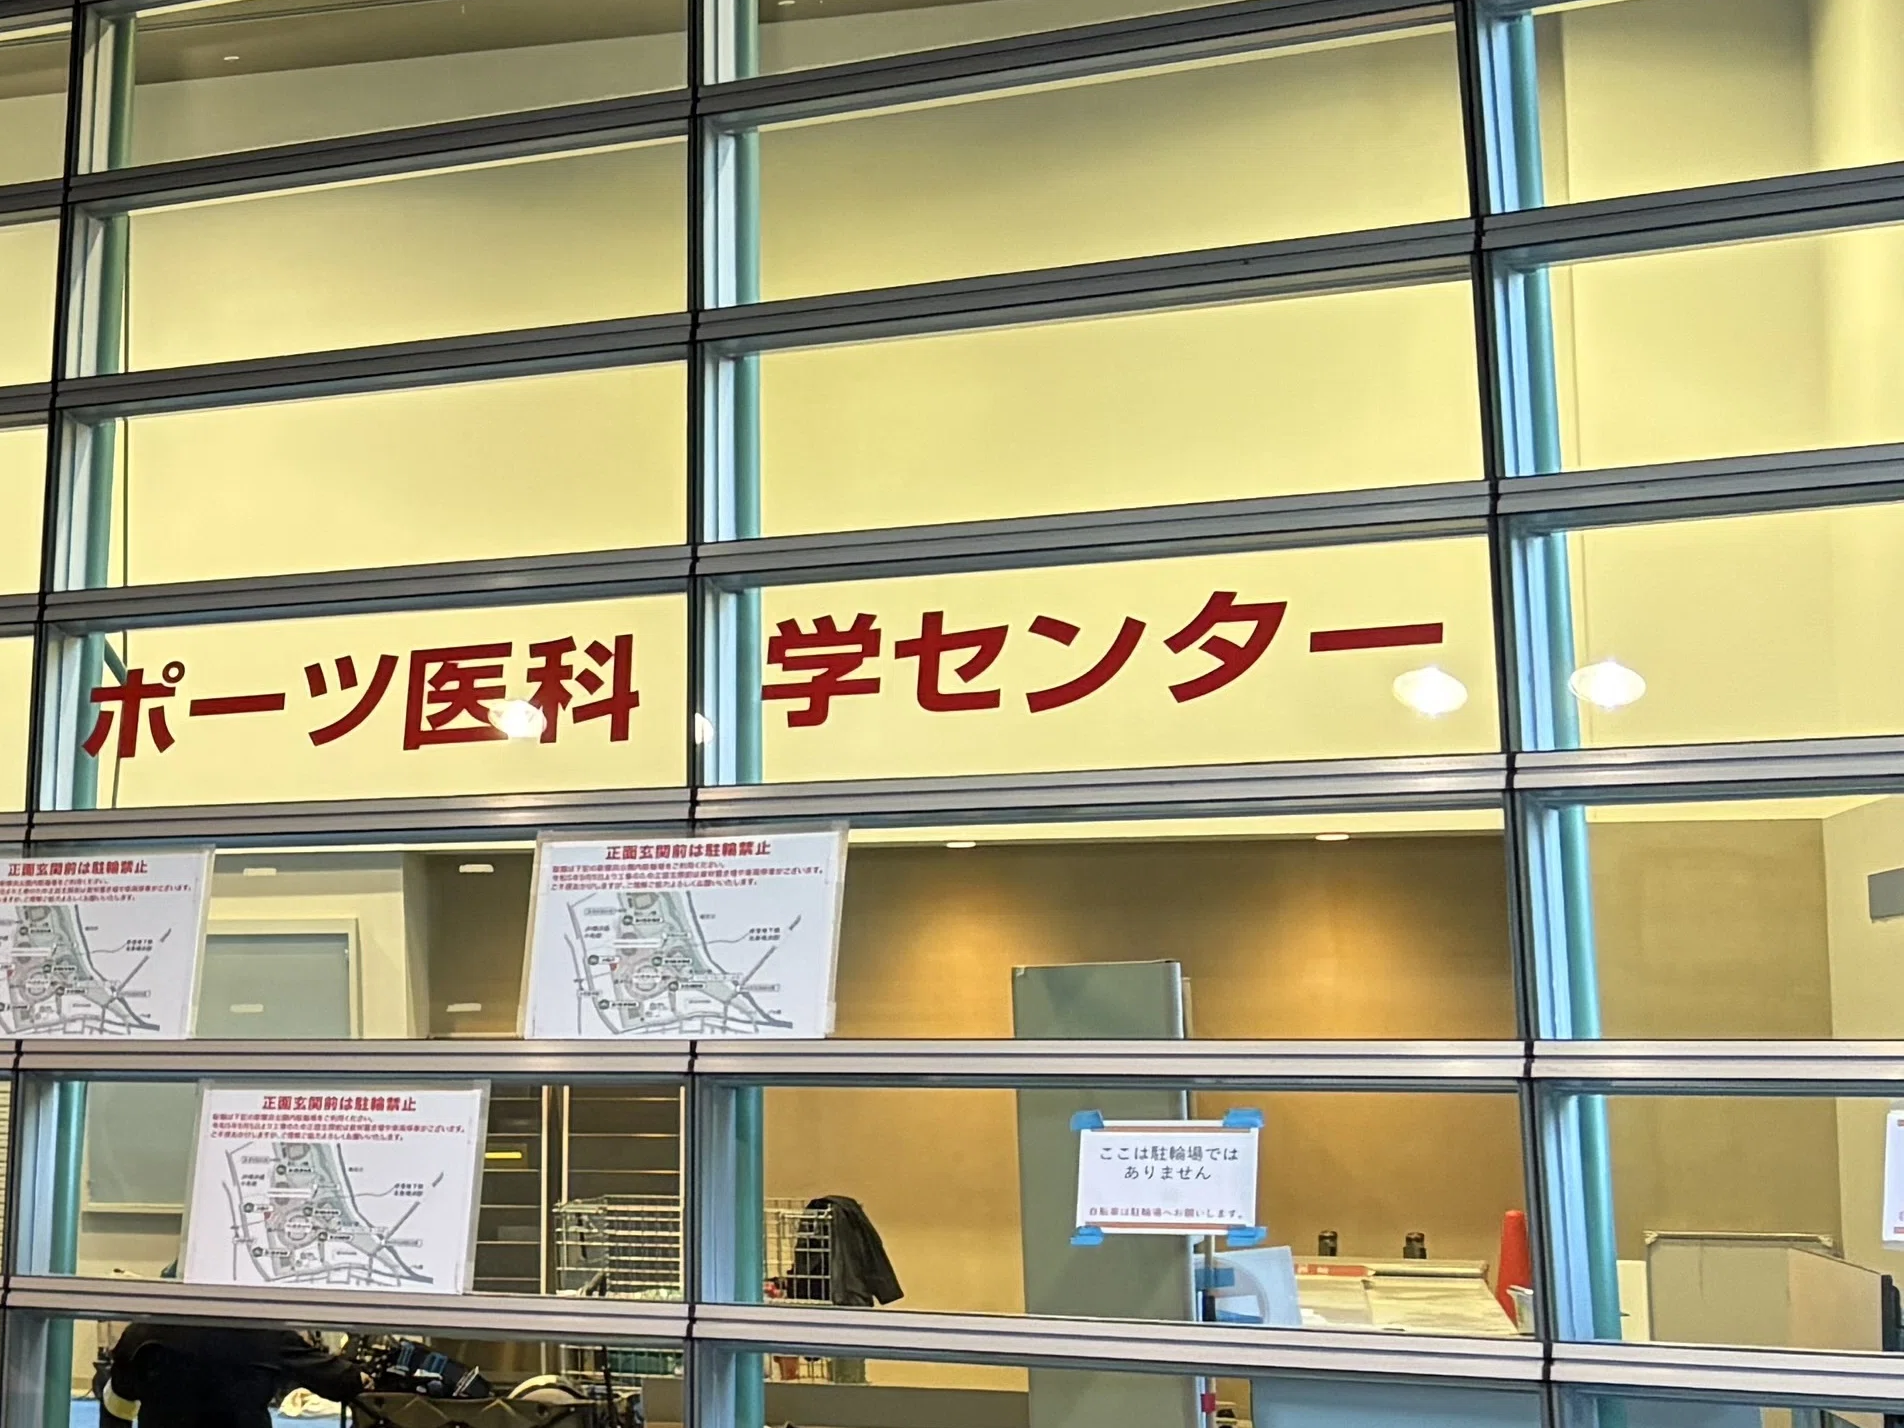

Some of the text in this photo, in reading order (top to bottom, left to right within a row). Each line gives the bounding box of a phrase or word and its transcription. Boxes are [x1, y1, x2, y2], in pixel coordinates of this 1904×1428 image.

[605, 840, 771, 860] 正面玄関前は駐輪禁止
[262, 1095, 417, 1112] 正面玄関前は駐輪禁止
[1099, 1145, 1239, 1162] ここは駐輪場では
[1124, 1165, 1212, 1180] ありません
